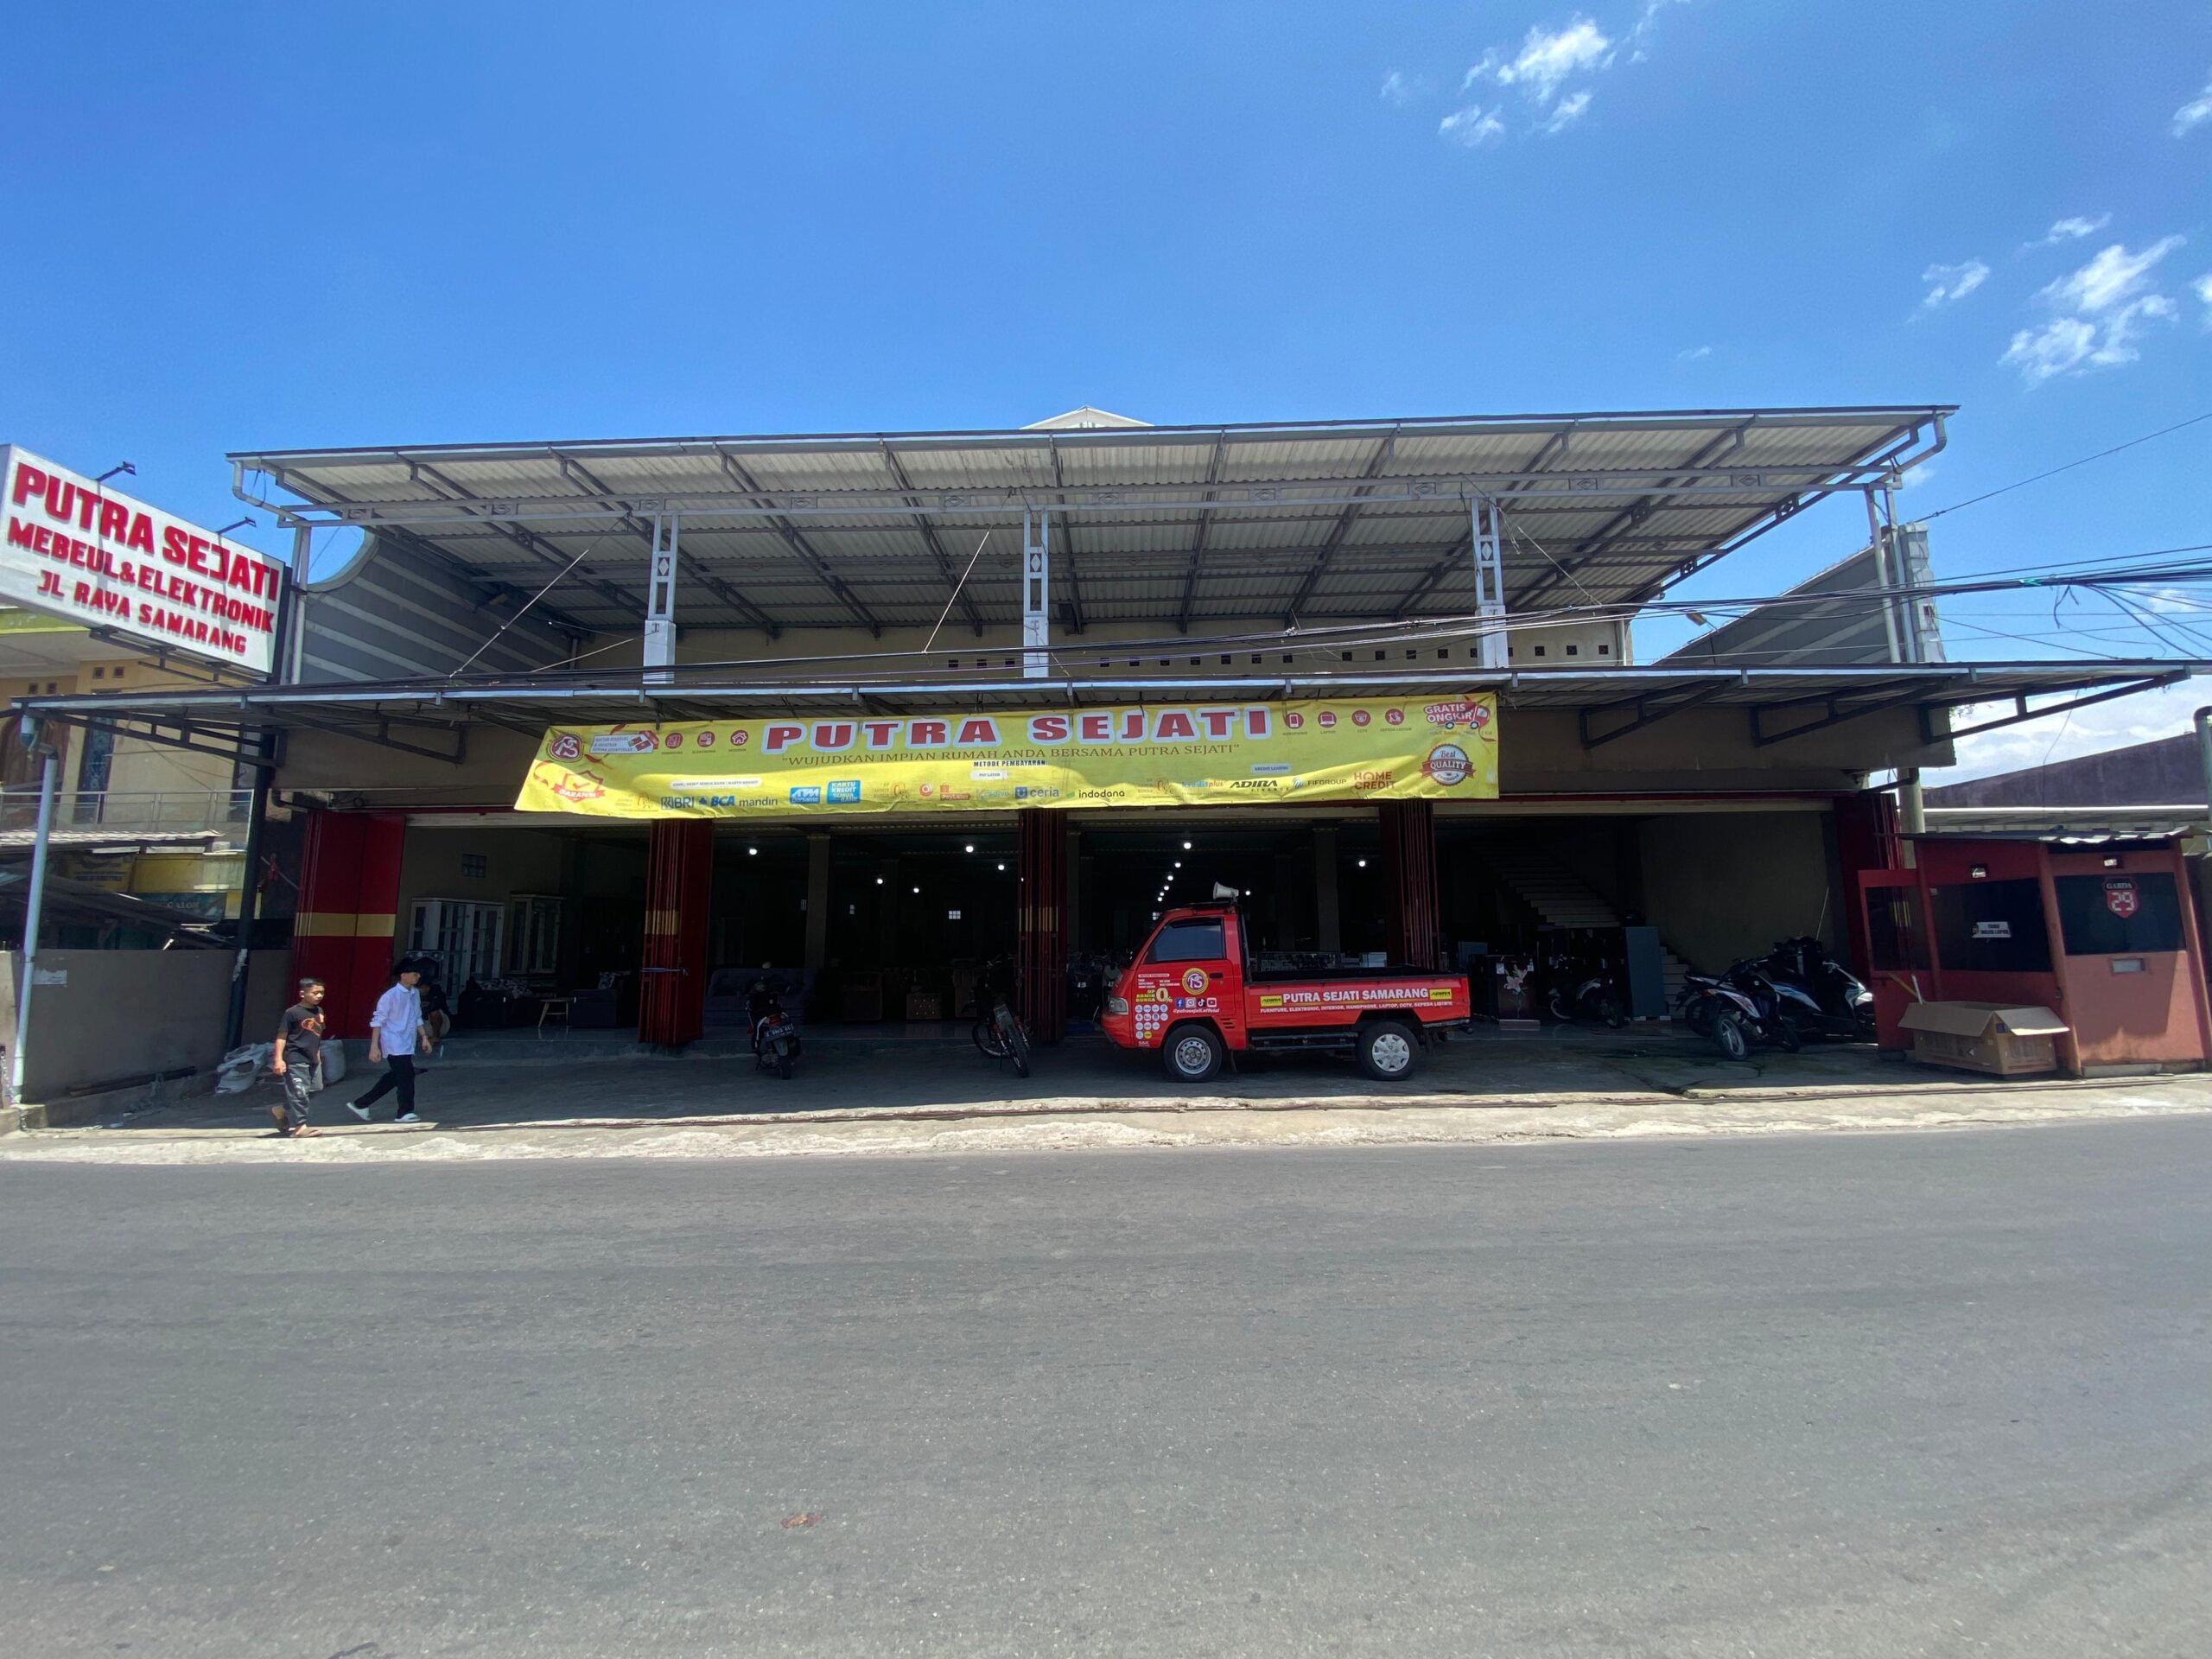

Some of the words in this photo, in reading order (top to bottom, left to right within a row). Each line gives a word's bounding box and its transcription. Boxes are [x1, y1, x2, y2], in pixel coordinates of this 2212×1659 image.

[13, 462, 155, 555] PUTRA
[162, 525, 279, 601] SEJATI
[38, 569, 64, 597] JL
[74, 582, 130, 617] RAYA
[138, 604, 246, 654] SAMARANG
[1424, 703, 1466, 715] GRATIS
[1427, 711, 1472, 722] ONGKIR
[766, 720, 997, 750] PUTRA
[1032, 710, 1267, 741] SEJATI
[880, 752, 936, 762] IMPIAN
[942, 750, 997, 760] RUMAH
[1002, 749, 1046, 758] ANDA
[1051, 747, 1123, 757] BERSAMA
[1128, 746, 1179, 756] PUTRA
[1430, 760, 1467, 771] QUALITY
[1354, 772, 1392, 781] HOME
[1230, 779, 1278, 789] ADIRA
[1355, 780, 1396, 791] CREDIT
[559, 789, 596, 798] GARANSI
[1030, 786, 1059, 798] ceria
[1078, 790, 1125, 798] indodana
[674, 797, 695, 809] BRI
[710, 795, 735, 807] BCA
[2111, 892, 2135, 912] 29
[1283, 992, 1321, 1003] PUTRA
[1323, 990, 1359, 1001] SEJATI
[1363, 988, 1428, 1000] SAMARANG
